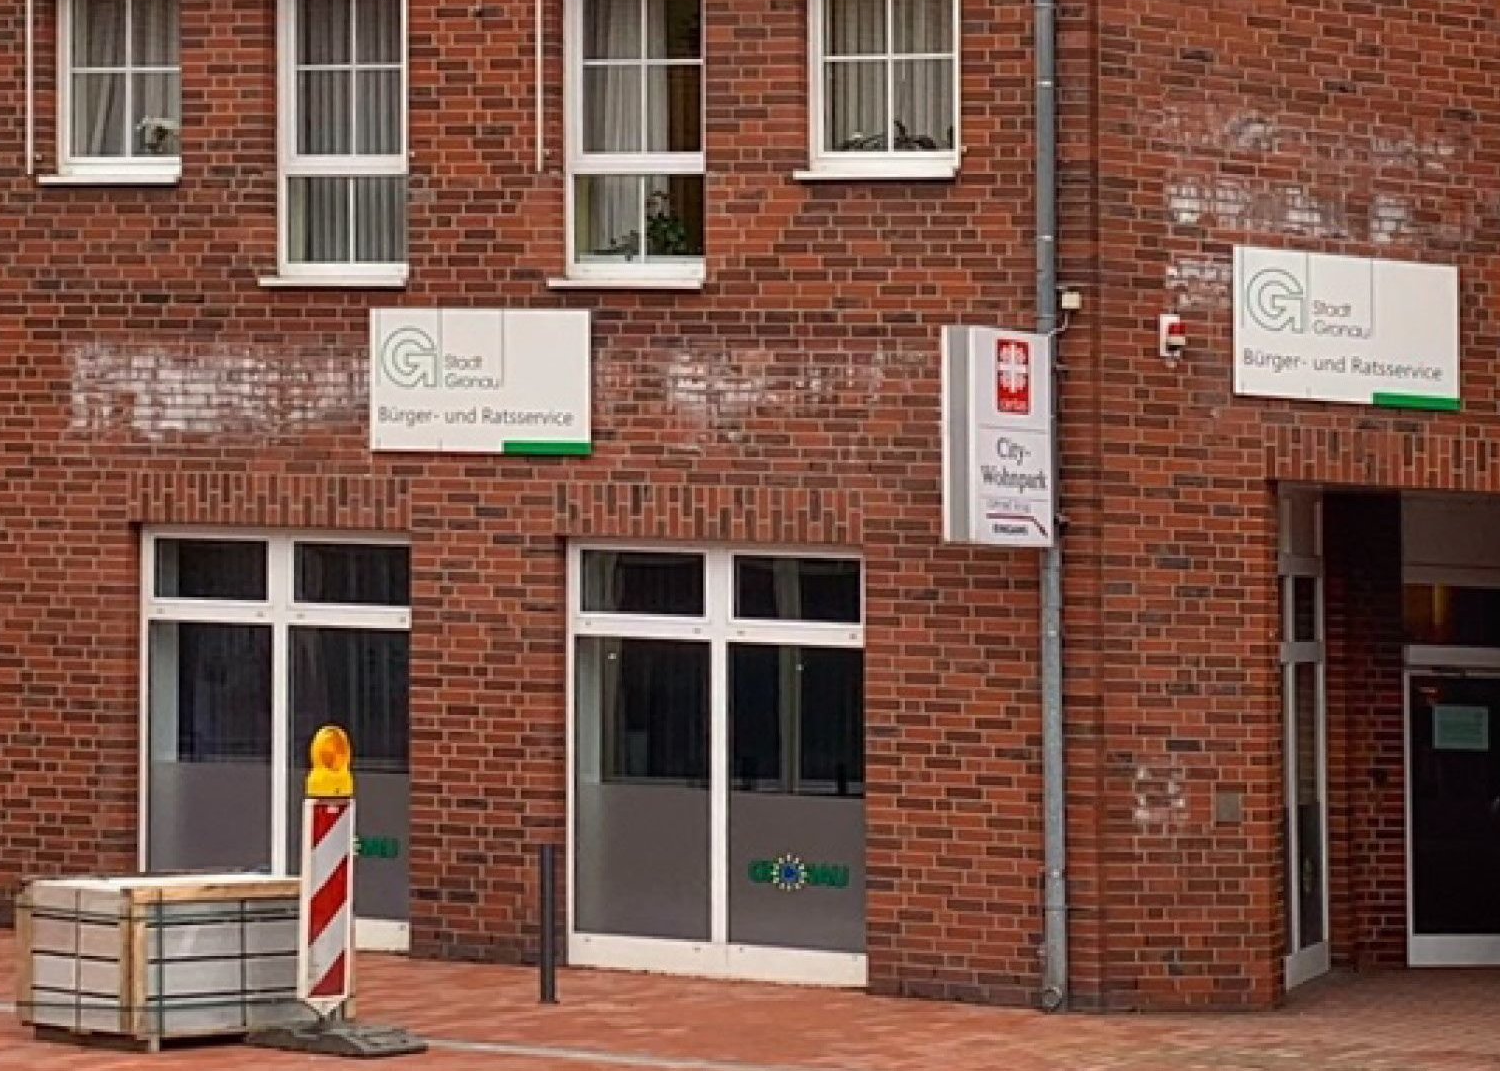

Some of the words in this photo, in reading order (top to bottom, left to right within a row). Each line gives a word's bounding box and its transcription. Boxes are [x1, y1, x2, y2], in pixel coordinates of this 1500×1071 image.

[1313, 300, 1351, 317] Stadt
[1313, 319, 1372, 339] Gronau
[444, 353, 482, 370] Stadt
[1243, 347, 1306, 373] Bürger-
[1314, 356, 1345, 371] und
[1350, 356, 1443, 381] Ratsservice
[444, 372, 500, 390] Gronau
[378, 406, 439, 426] Bürger-
[444, 406, 476, 424] und
[481, 406, 574, 426] Ratsservice
[997, 437, 1032, 465] City-
[980, 465, 1048, 493] Wohnpark
